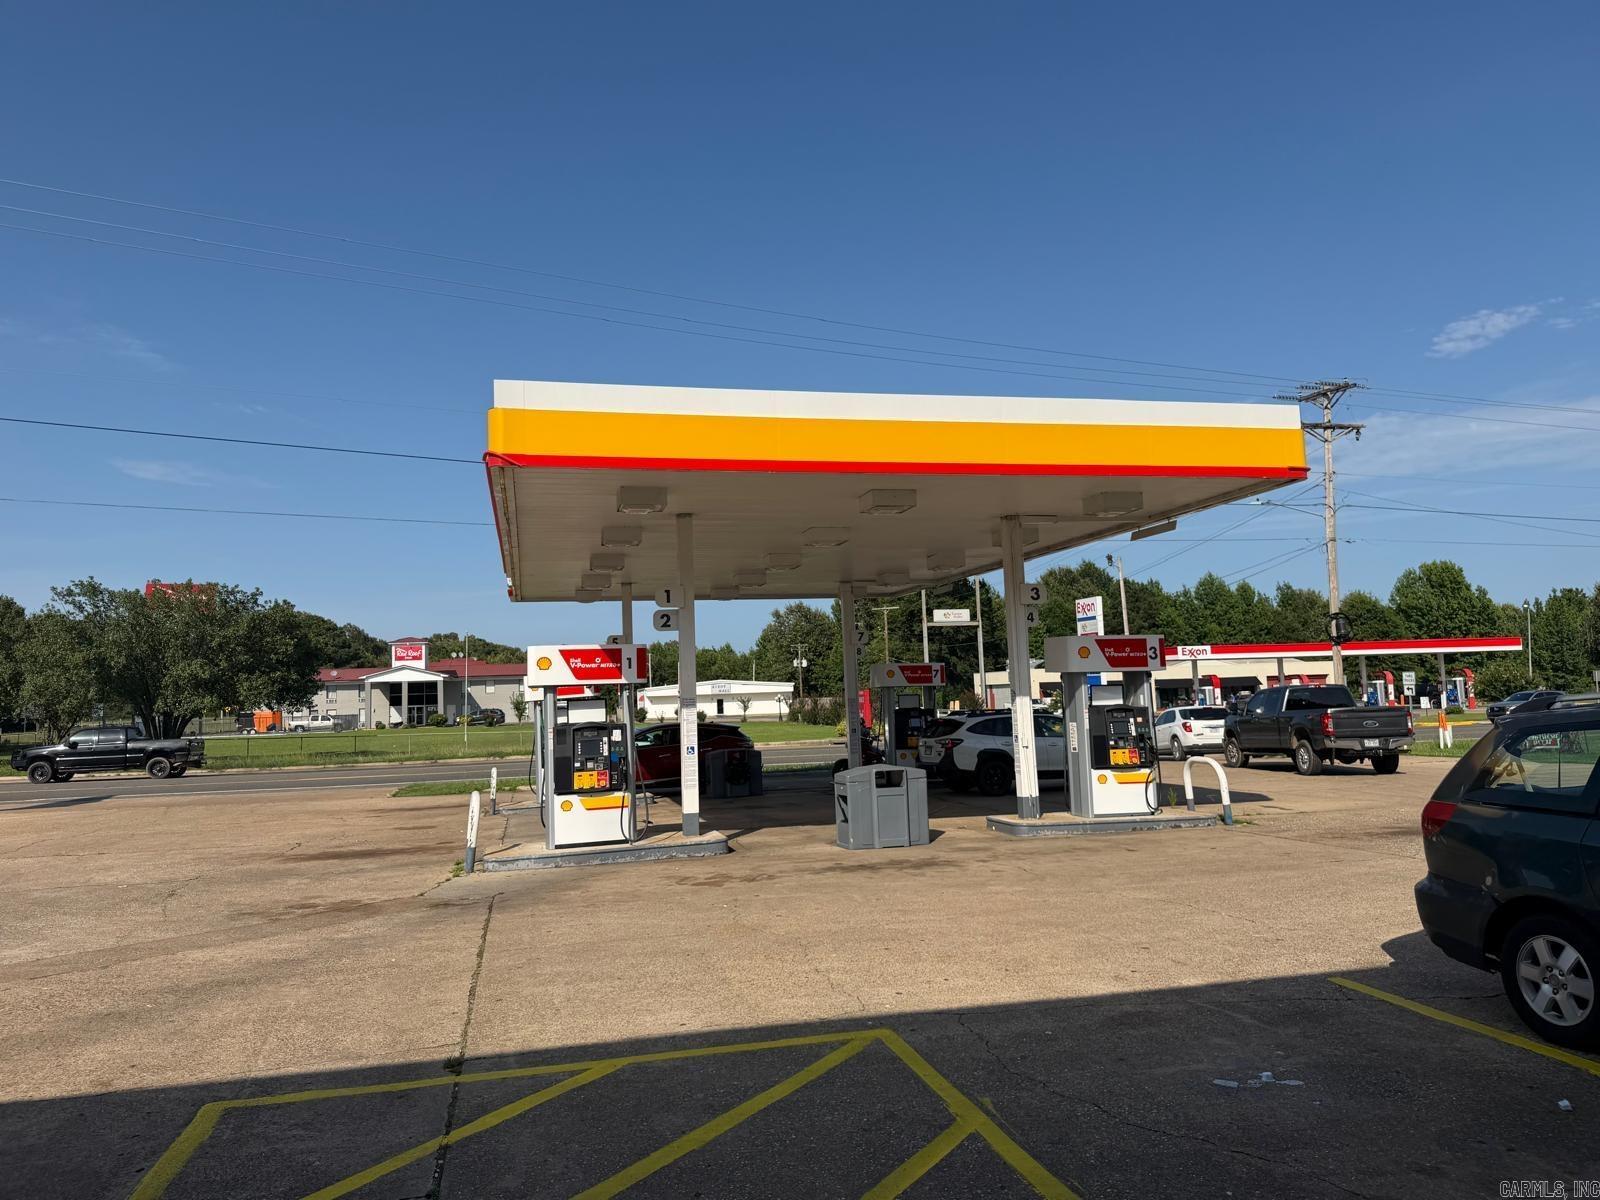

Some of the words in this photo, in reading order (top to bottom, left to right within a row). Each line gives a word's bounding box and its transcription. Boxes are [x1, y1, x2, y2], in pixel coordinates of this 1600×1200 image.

[664, 589, 671, 603] 1
[1030, 587, 1040, 601] 3
[1077, 602, 1096, 616] Exxon
[660, 613, 671, 628] 2
[1027, 612, 1034, 623] 4
[1148, 646, 1158, 660] 3
[1181, 647, 1208, 659] Exxon
[626, 657, 632, 669] 1
[933, 670, 939, 679] 7
